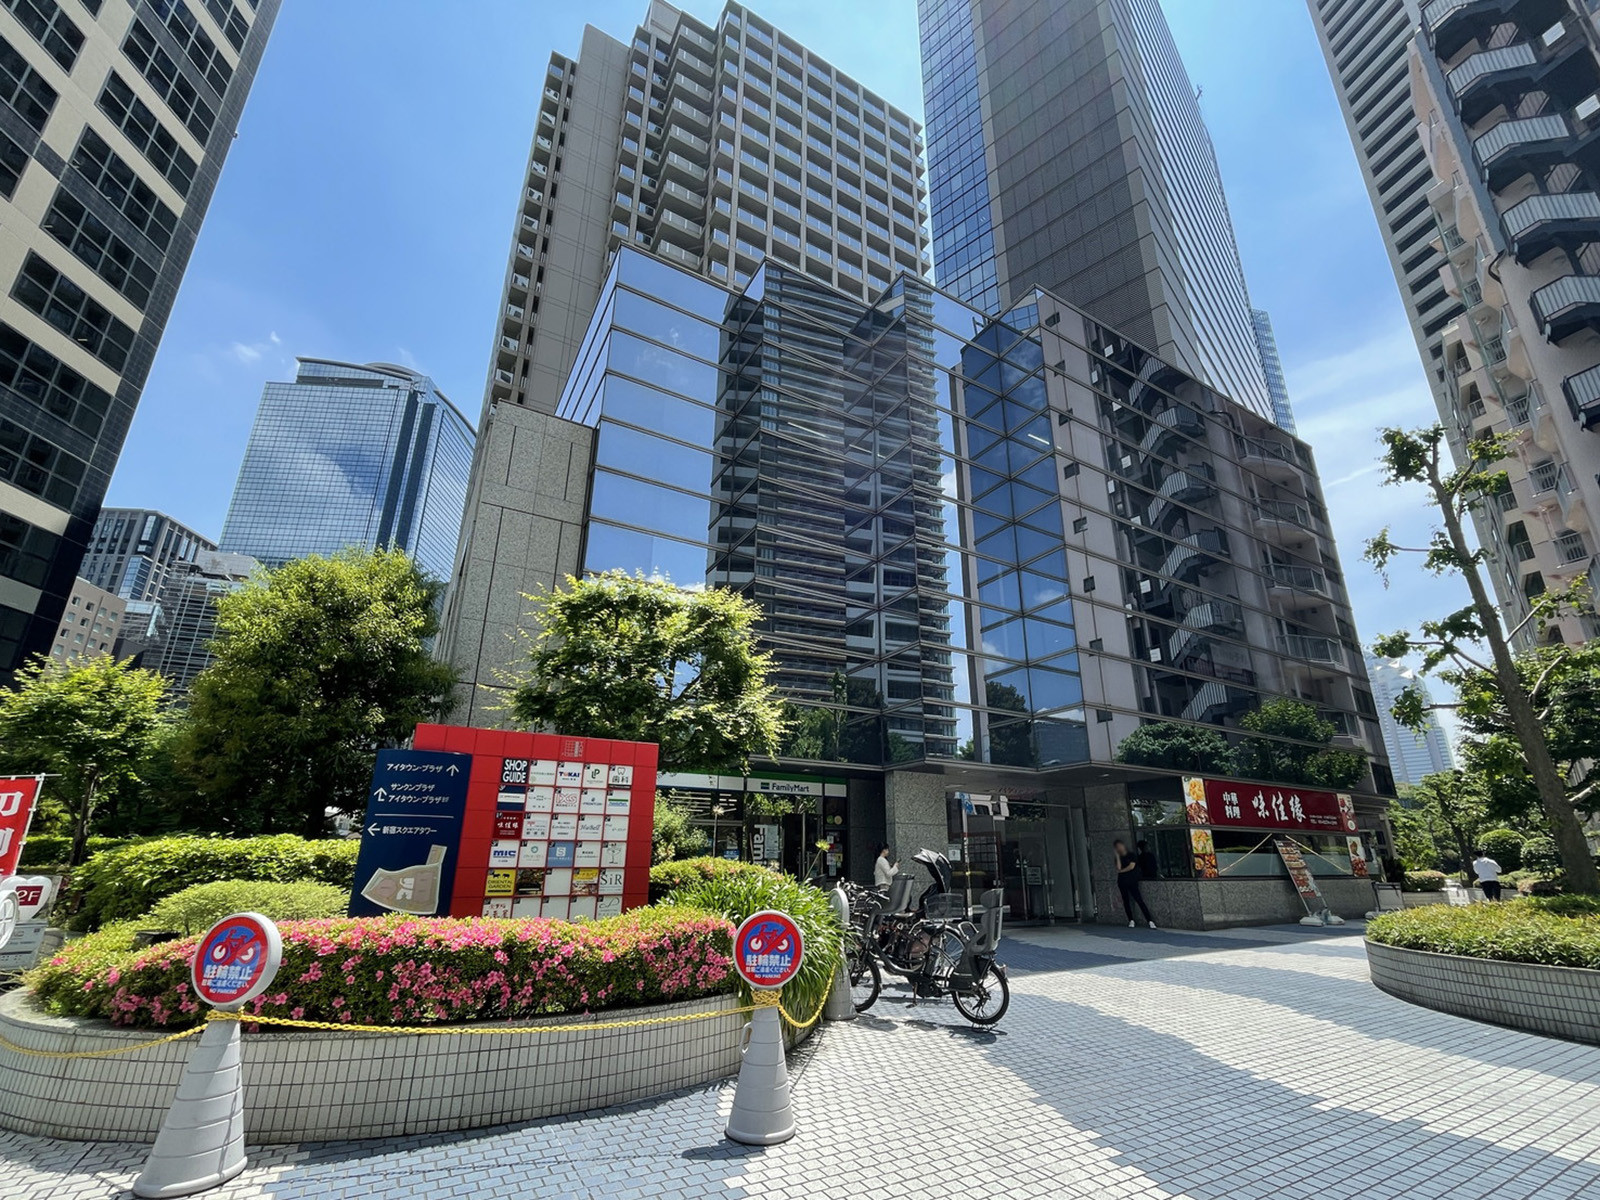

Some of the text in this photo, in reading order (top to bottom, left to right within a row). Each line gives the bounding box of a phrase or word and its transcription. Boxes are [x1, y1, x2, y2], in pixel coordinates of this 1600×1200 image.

[504, 759, 528, 771] SHOP
[502, 770, 526, 783] GUIDE
[771, 782, 810, 793] FamilyMart
[1222, 791, 1239, 805] 中華
[1224, 805, 1242, 819] 料理
[1251, 789, 1307, 823] 味佳縁
[745, 954, 791, 967] 駐輪禁止
[203, 965, 253, 981] 駐輪禁止
